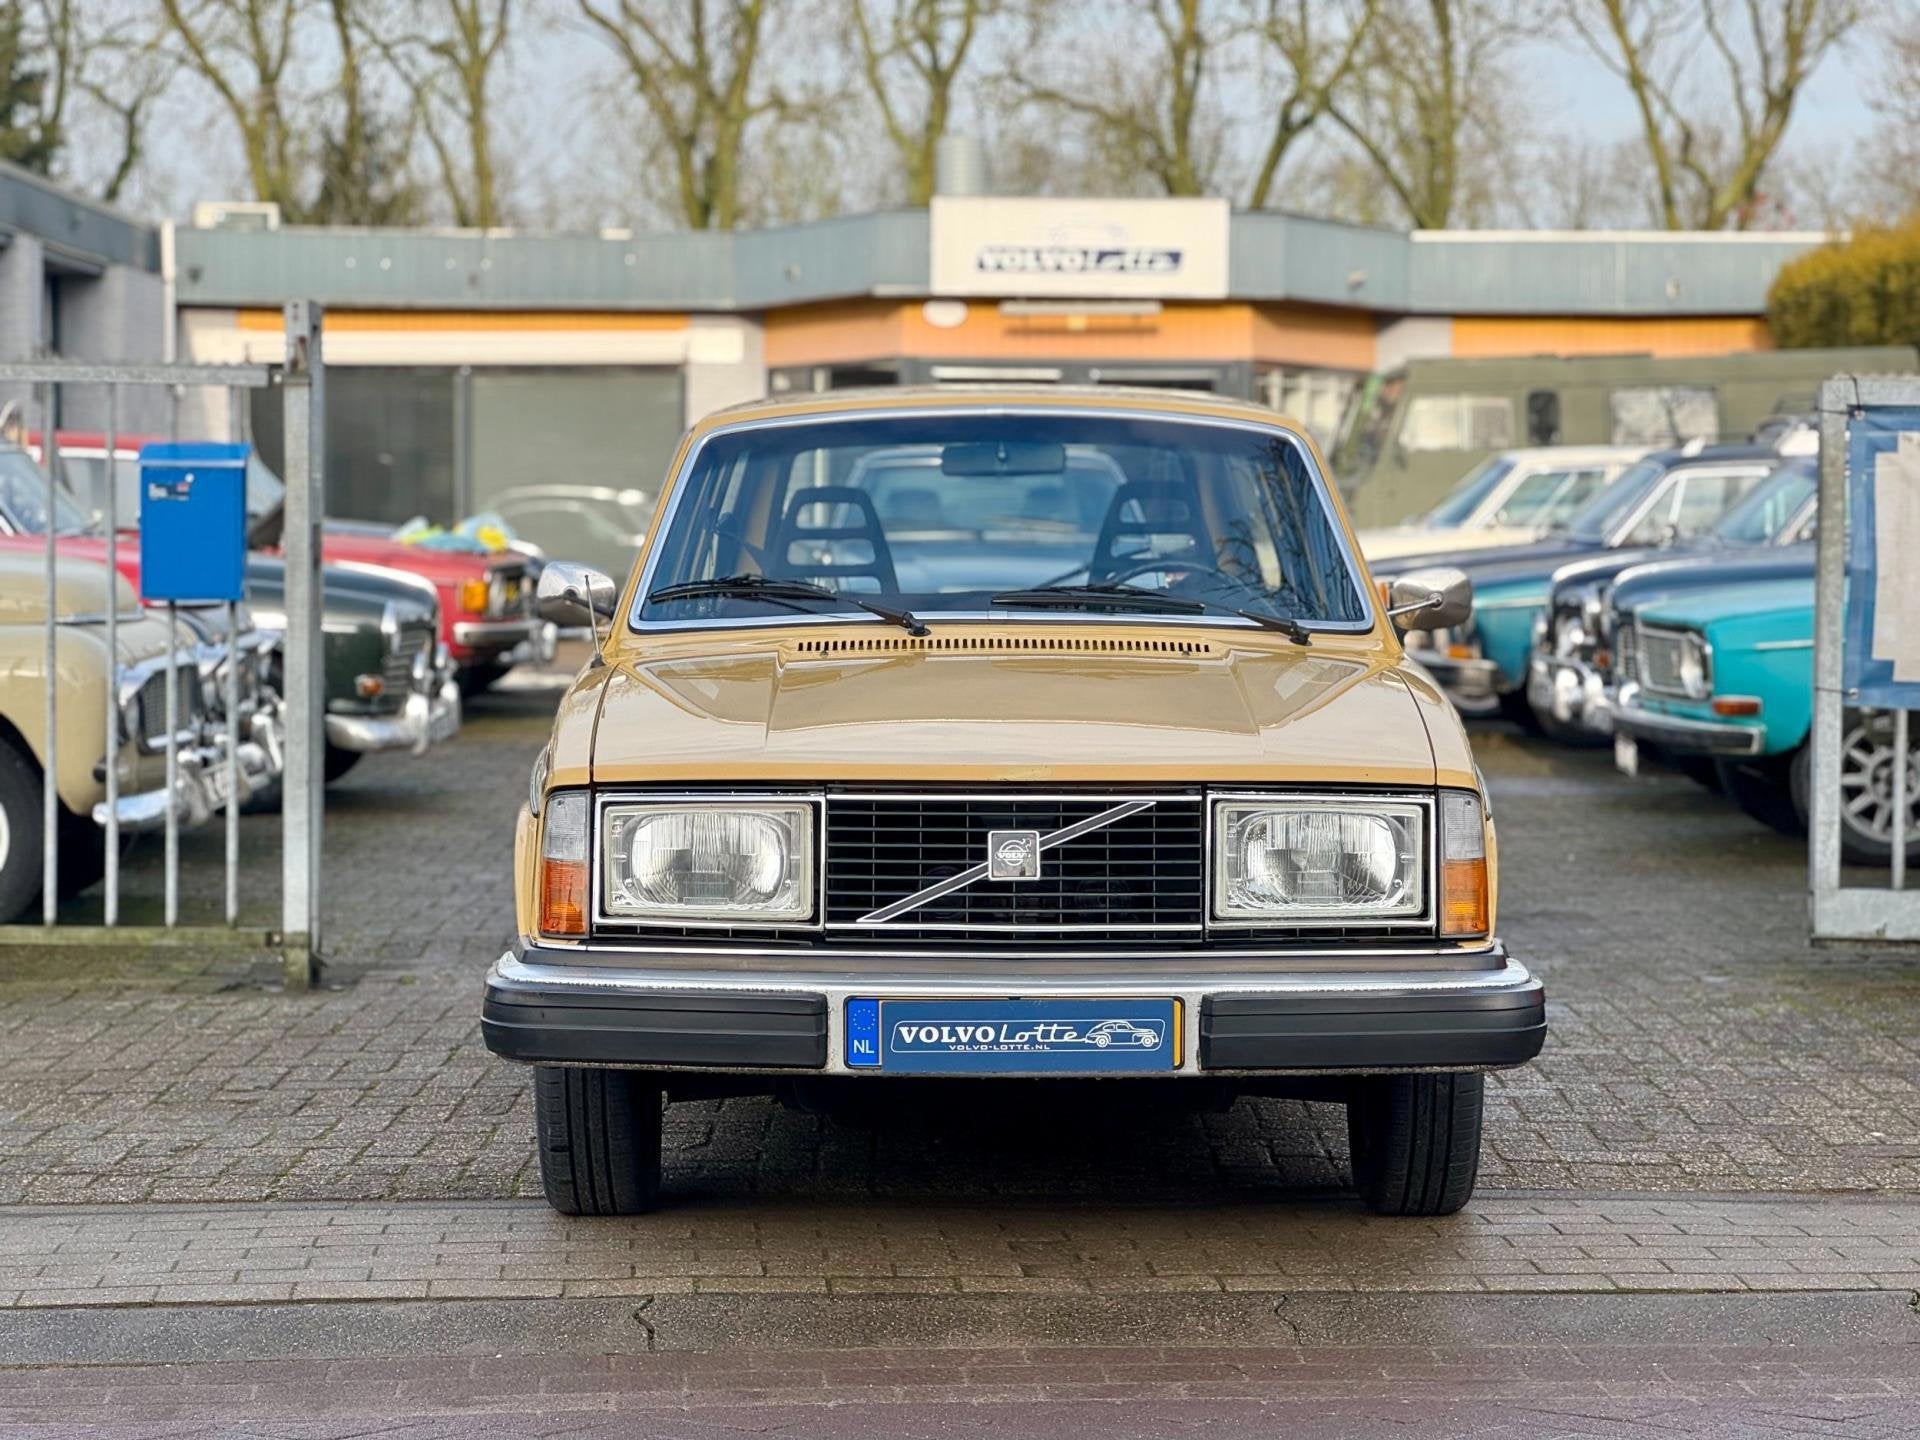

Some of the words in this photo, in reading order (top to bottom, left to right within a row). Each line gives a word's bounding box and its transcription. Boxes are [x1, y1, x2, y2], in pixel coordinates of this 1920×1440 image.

[899, 1025, 995, 1043] VOLVO
[1000, 1024, 1087, 1043] Lotte
[853, 1040, 875, 1054] NL
